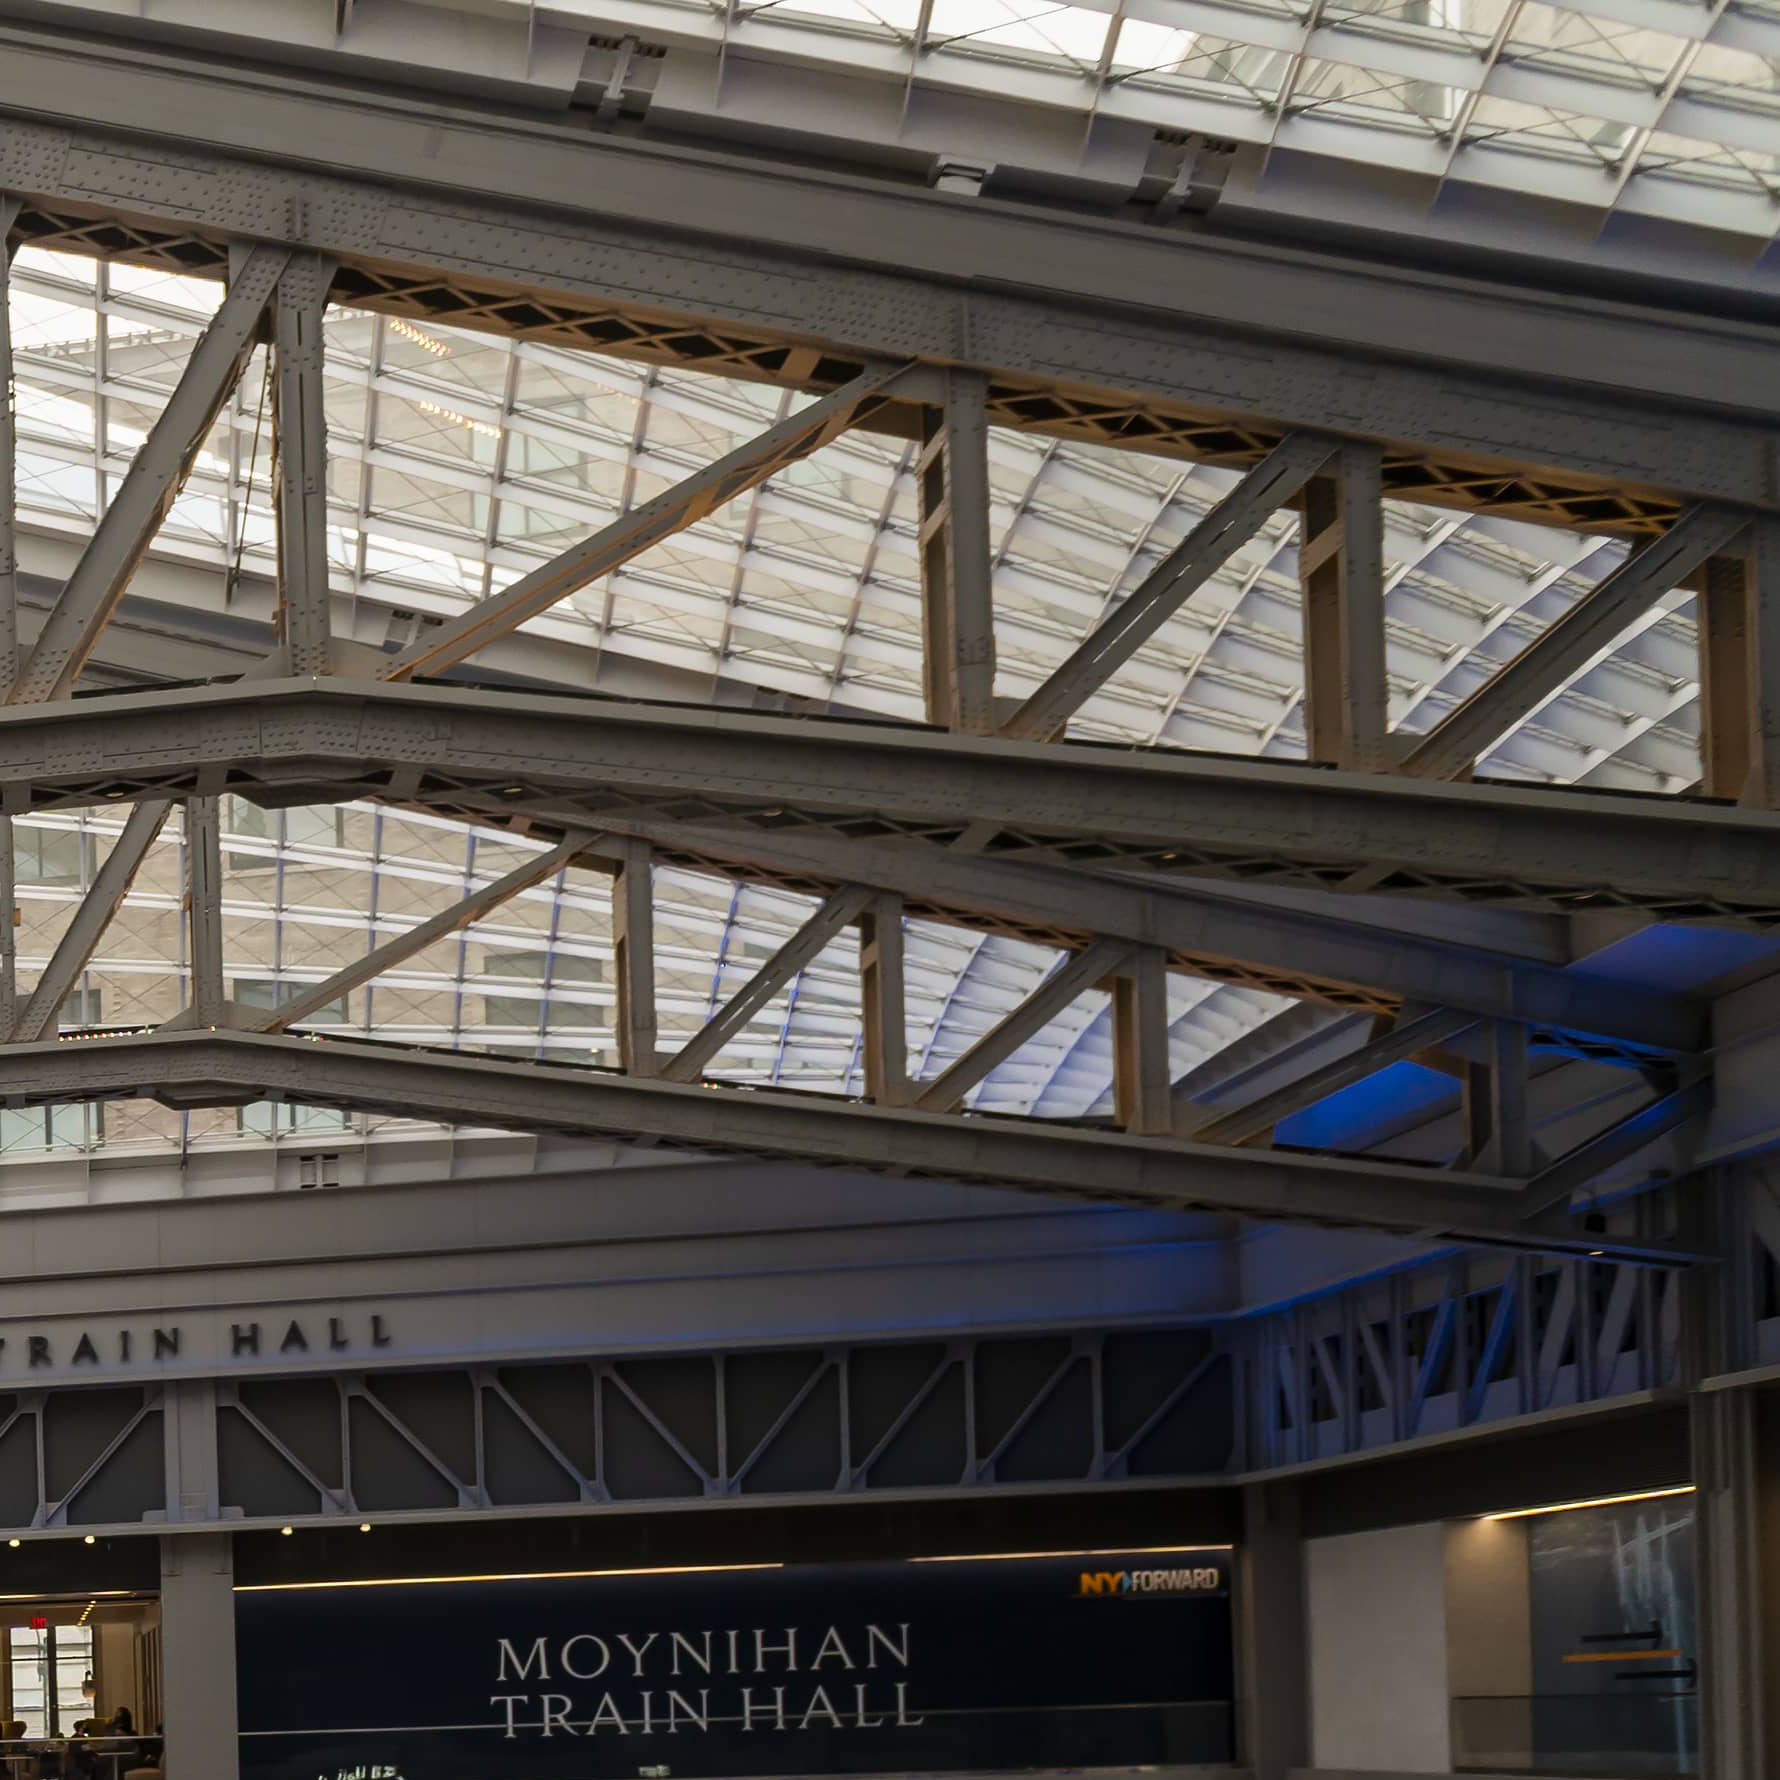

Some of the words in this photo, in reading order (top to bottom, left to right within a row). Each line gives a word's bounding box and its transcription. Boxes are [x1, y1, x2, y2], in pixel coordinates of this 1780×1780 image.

[231, 1314, 391, 1356] HALL
[1080, 1571, 1123, 1595] NY
[1132, 1568, 1219, 1592] FORWARD
[495, 1623, 911, 1681] MOYNIHAN
[489, 1688, 710, 1738] TRAIN
[741, 1682, 924, 1732] HALL
